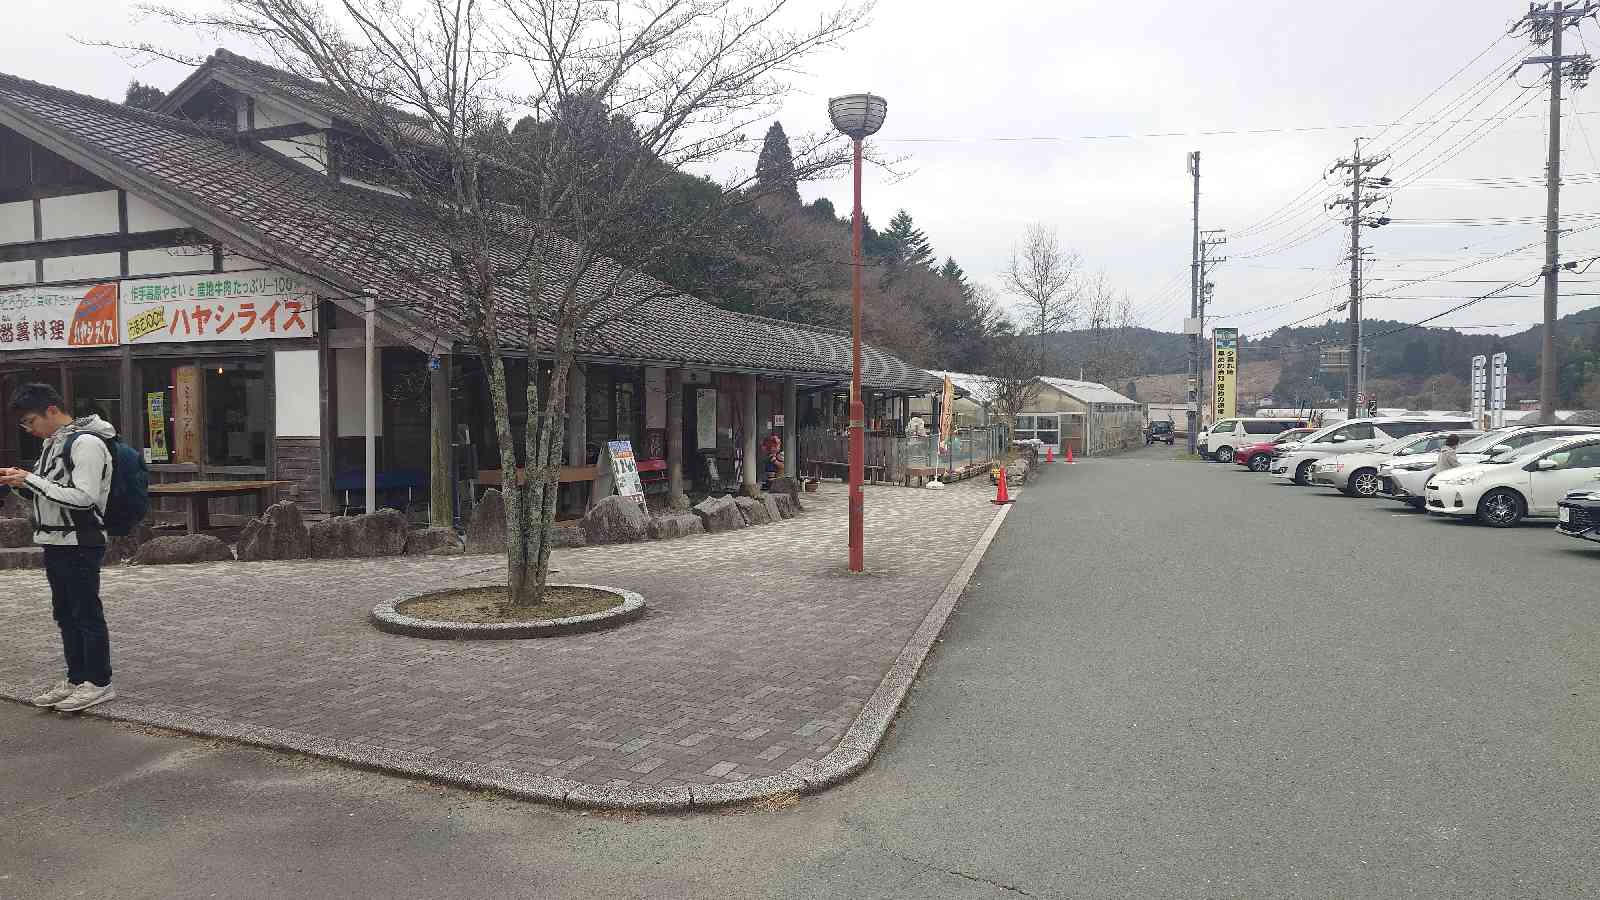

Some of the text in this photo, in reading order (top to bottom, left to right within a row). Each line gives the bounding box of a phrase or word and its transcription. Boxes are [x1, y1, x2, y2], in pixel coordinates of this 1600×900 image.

[169, 302, 306, 336] ハヤシライス
